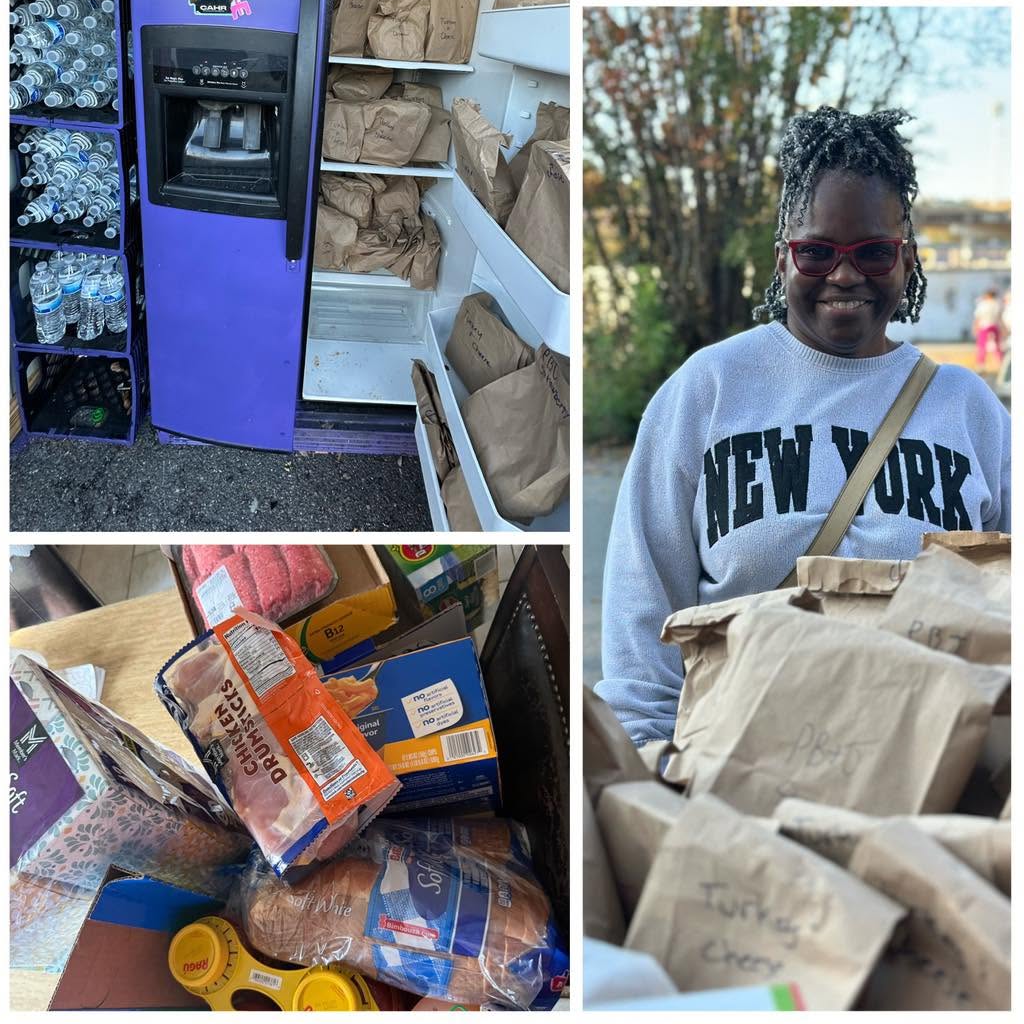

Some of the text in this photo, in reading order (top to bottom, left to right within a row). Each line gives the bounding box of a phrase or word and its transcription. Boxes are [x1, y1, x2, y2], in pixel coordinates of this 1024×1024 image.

[703, 424, 974, 549] NEW YORK
[223, 622, 246, 640] Nutrition
[324, 624, 346, 641] B12
[413, 685, 448, 702] no artificial
[417, 697, 453, 713] no artificial
[420, 702, 455, 717] preservatives
[422, 710, 458, 726] no artificial
[436, 719, 449, 727] dyes
[215, 702, 259, 777] CHICKEN
[220, 678, 288, 785] DRUMSTICKS
